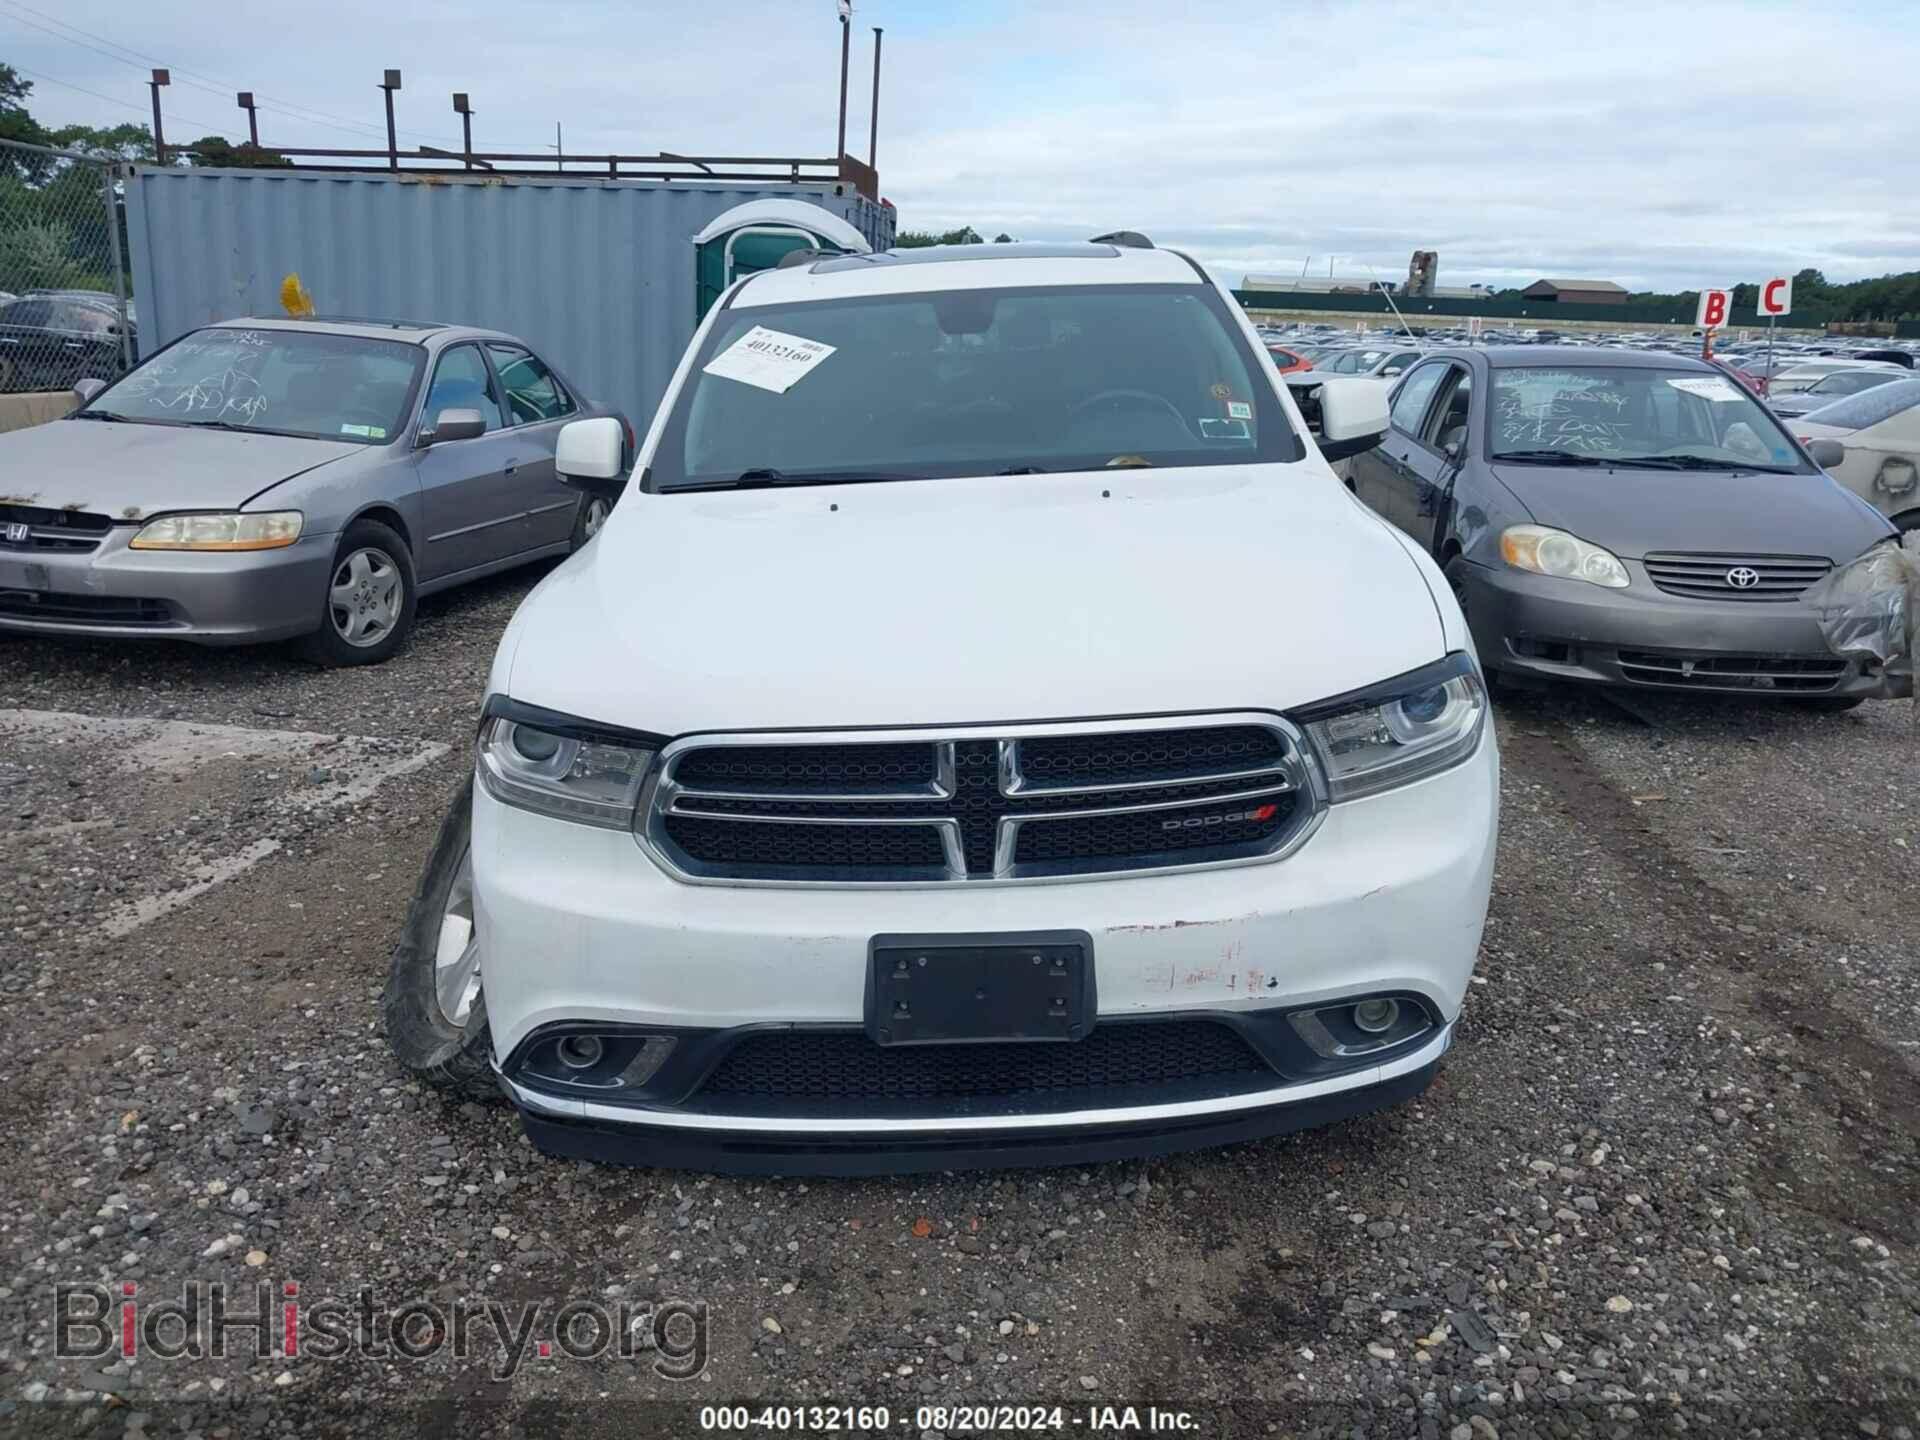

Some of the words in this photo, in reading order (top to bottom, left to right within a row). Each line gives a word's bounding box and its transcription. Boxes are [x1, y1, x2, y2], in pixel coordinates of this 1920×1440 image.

[1704, 292, 1726, 325] B
[1764, 279, 1786, 312] C
[746, 340, 813, 362] 40132160
